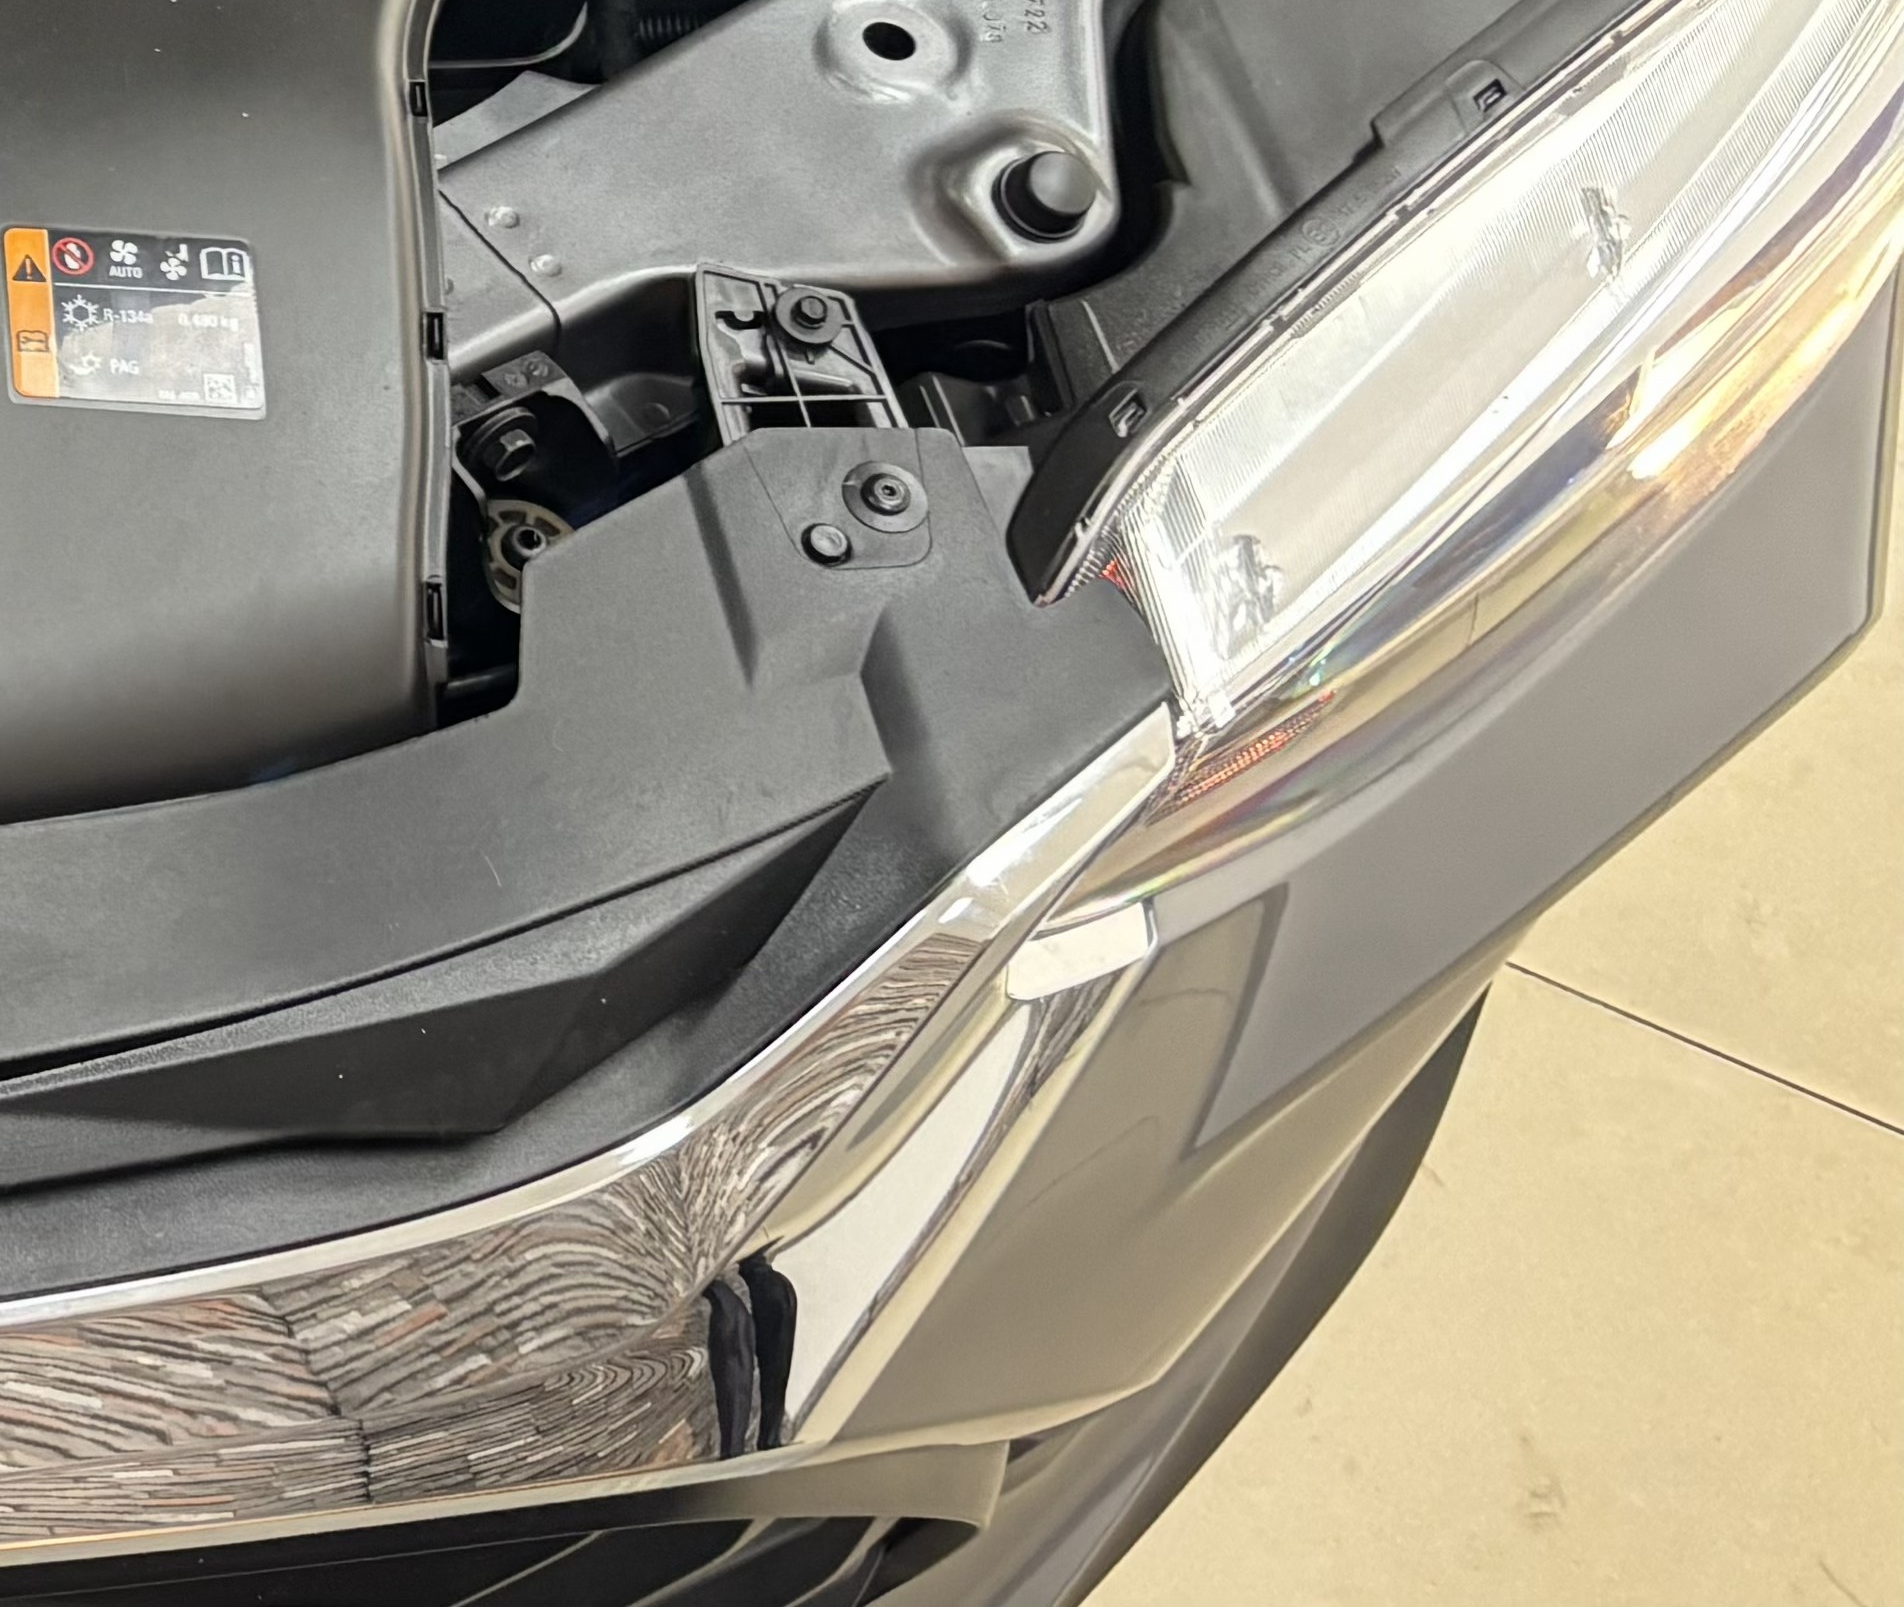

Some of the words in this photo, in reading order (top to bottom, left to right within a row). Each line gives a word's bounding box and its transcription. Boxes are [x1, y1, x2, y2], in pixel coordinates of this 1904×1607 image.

[109, 265, 143, 280] AUTO
[103, 308, 154, 325] R-134a
[109, 359, 140, 375] PAG
